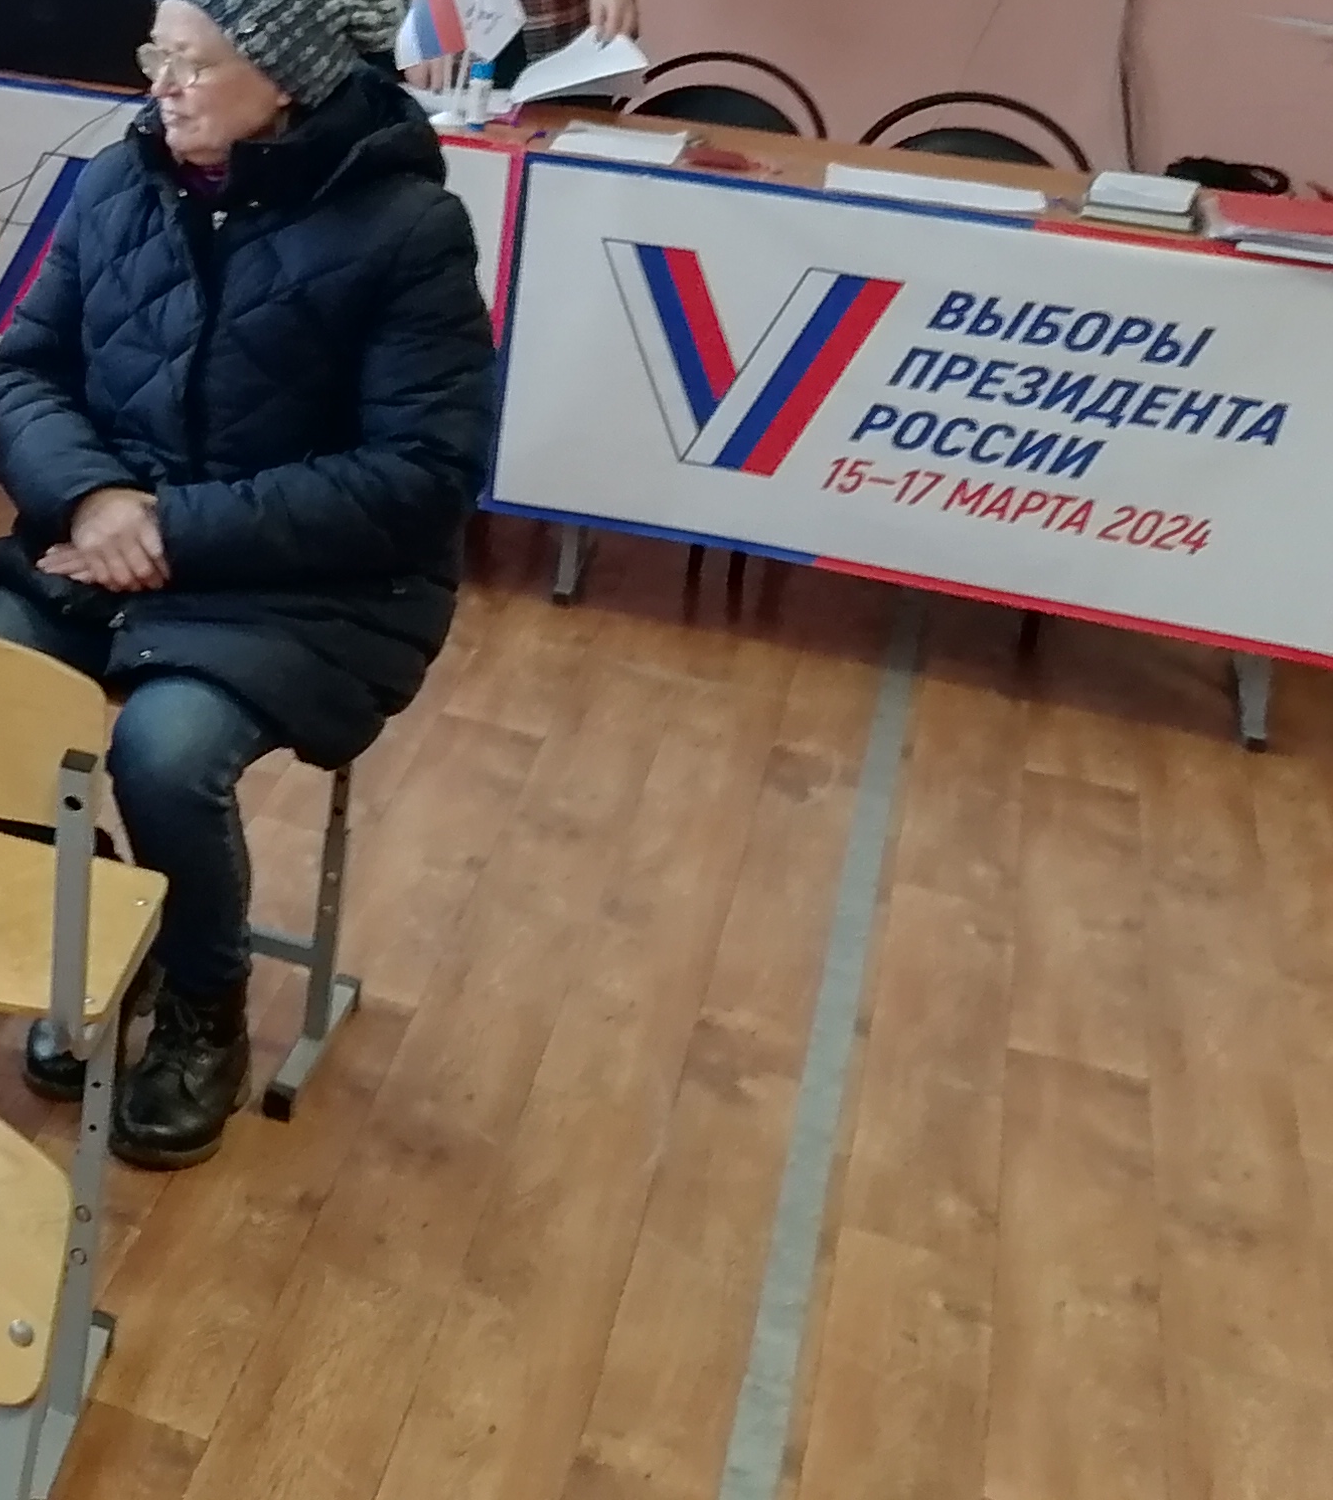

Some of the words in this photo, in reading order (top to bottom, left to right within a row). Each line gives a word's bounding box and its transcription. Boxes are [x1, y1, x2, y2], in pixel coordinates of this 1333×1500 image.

[925, 290, 1216, 368] ВЫБОРЫ
[886, 347, 1290, 446] ПРЕЗИДЕНТА
[848, 403, 1107, 479] РОССИИ
[941, 477, 1096, 536] МАРТА
[1096, 505, 1214, 556] 2024
